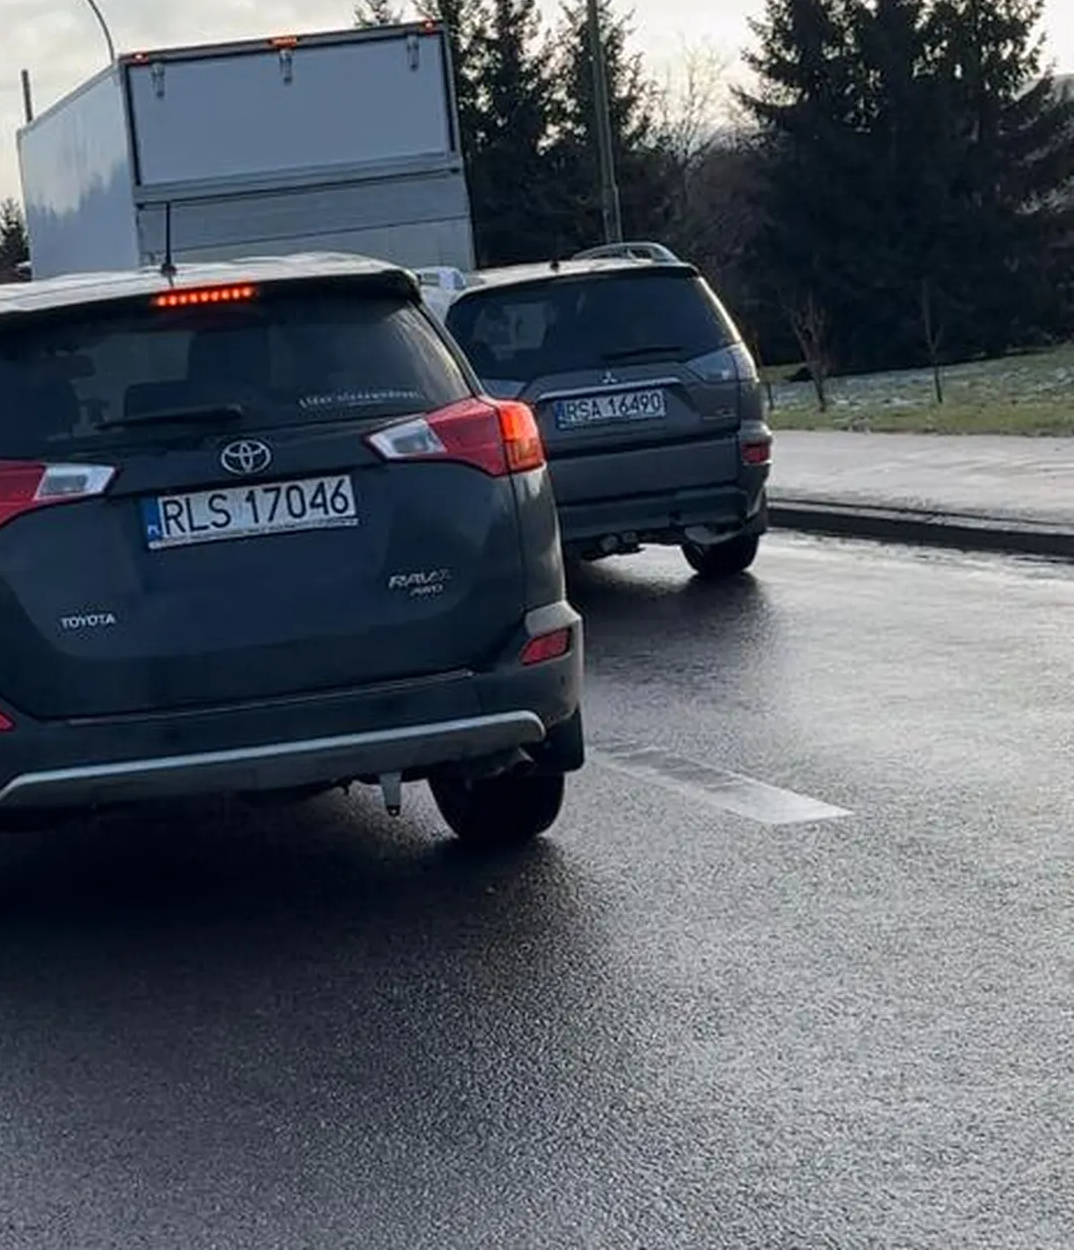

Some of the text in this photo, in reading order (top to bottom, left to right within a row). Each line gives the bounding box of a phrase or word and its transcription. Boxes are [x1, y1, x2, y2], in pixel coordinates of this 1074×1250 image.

[565, 392, 661, 421] RSA 16490
[162, 493, 232, 535] RLS
[244, 479, 350, 524] 17046
[60, 613, 116, 629] TOYOTA
